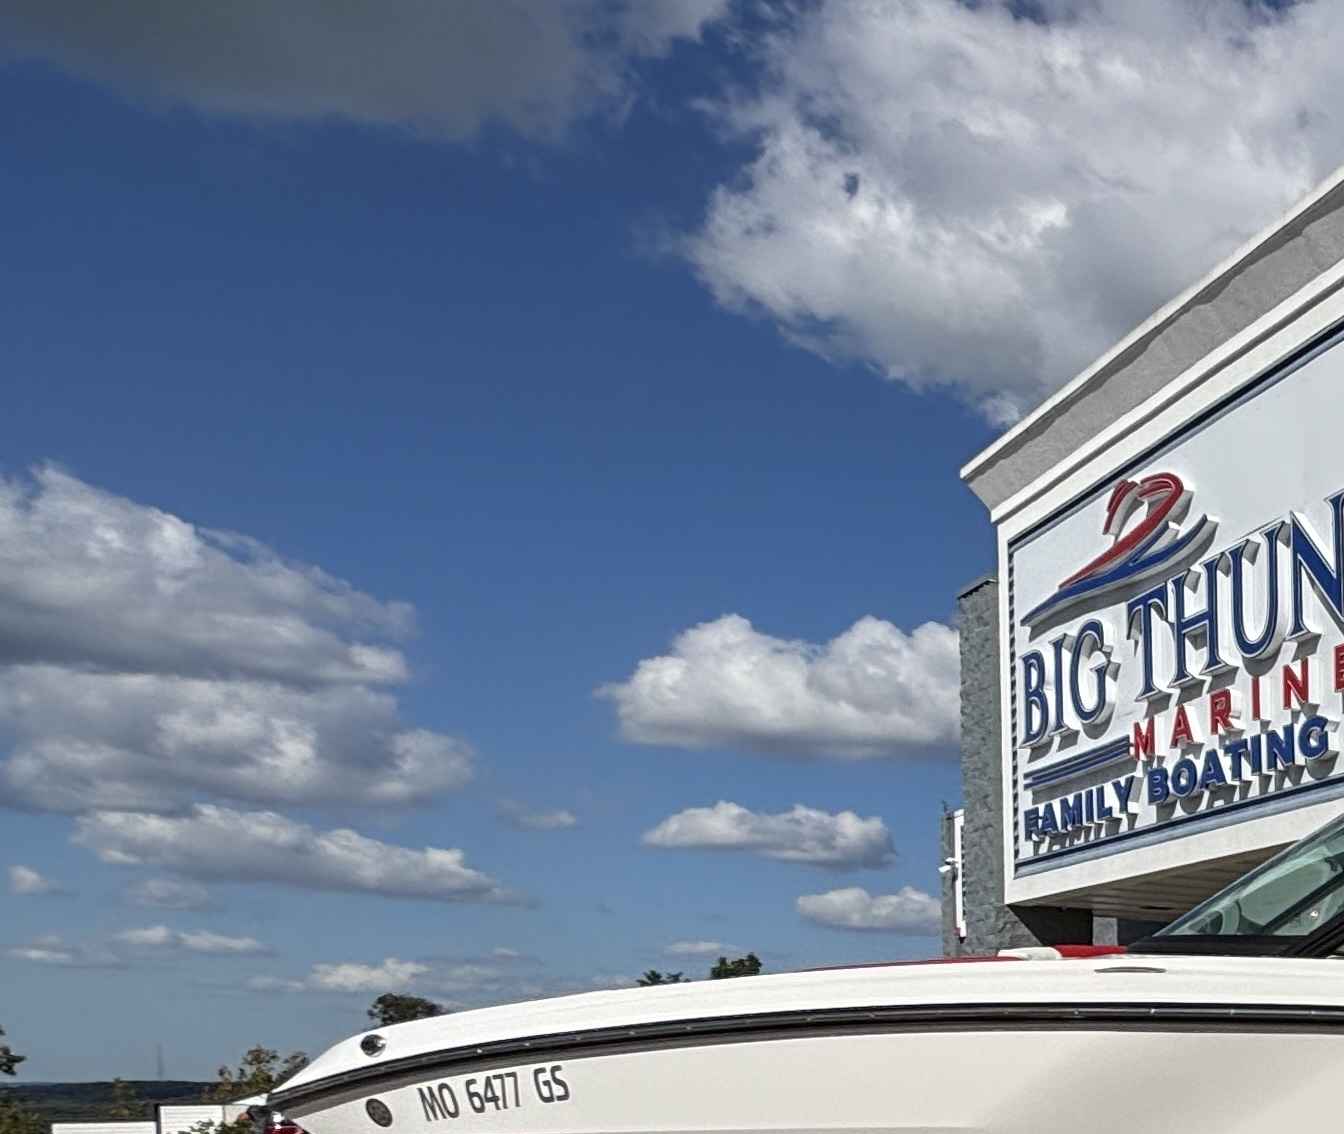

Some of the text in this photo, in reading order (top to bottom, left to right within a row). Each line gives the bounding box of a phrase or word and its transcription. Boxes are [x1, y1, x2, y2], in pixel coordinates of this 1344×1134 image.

[1019, 618, 1109, 749] BIG
[1024, 775, 1134, 841] FAMILY
[1147, 715, 1330, 805] BOATING
[418, 1064, 571, 1122] MO 6477 GS
